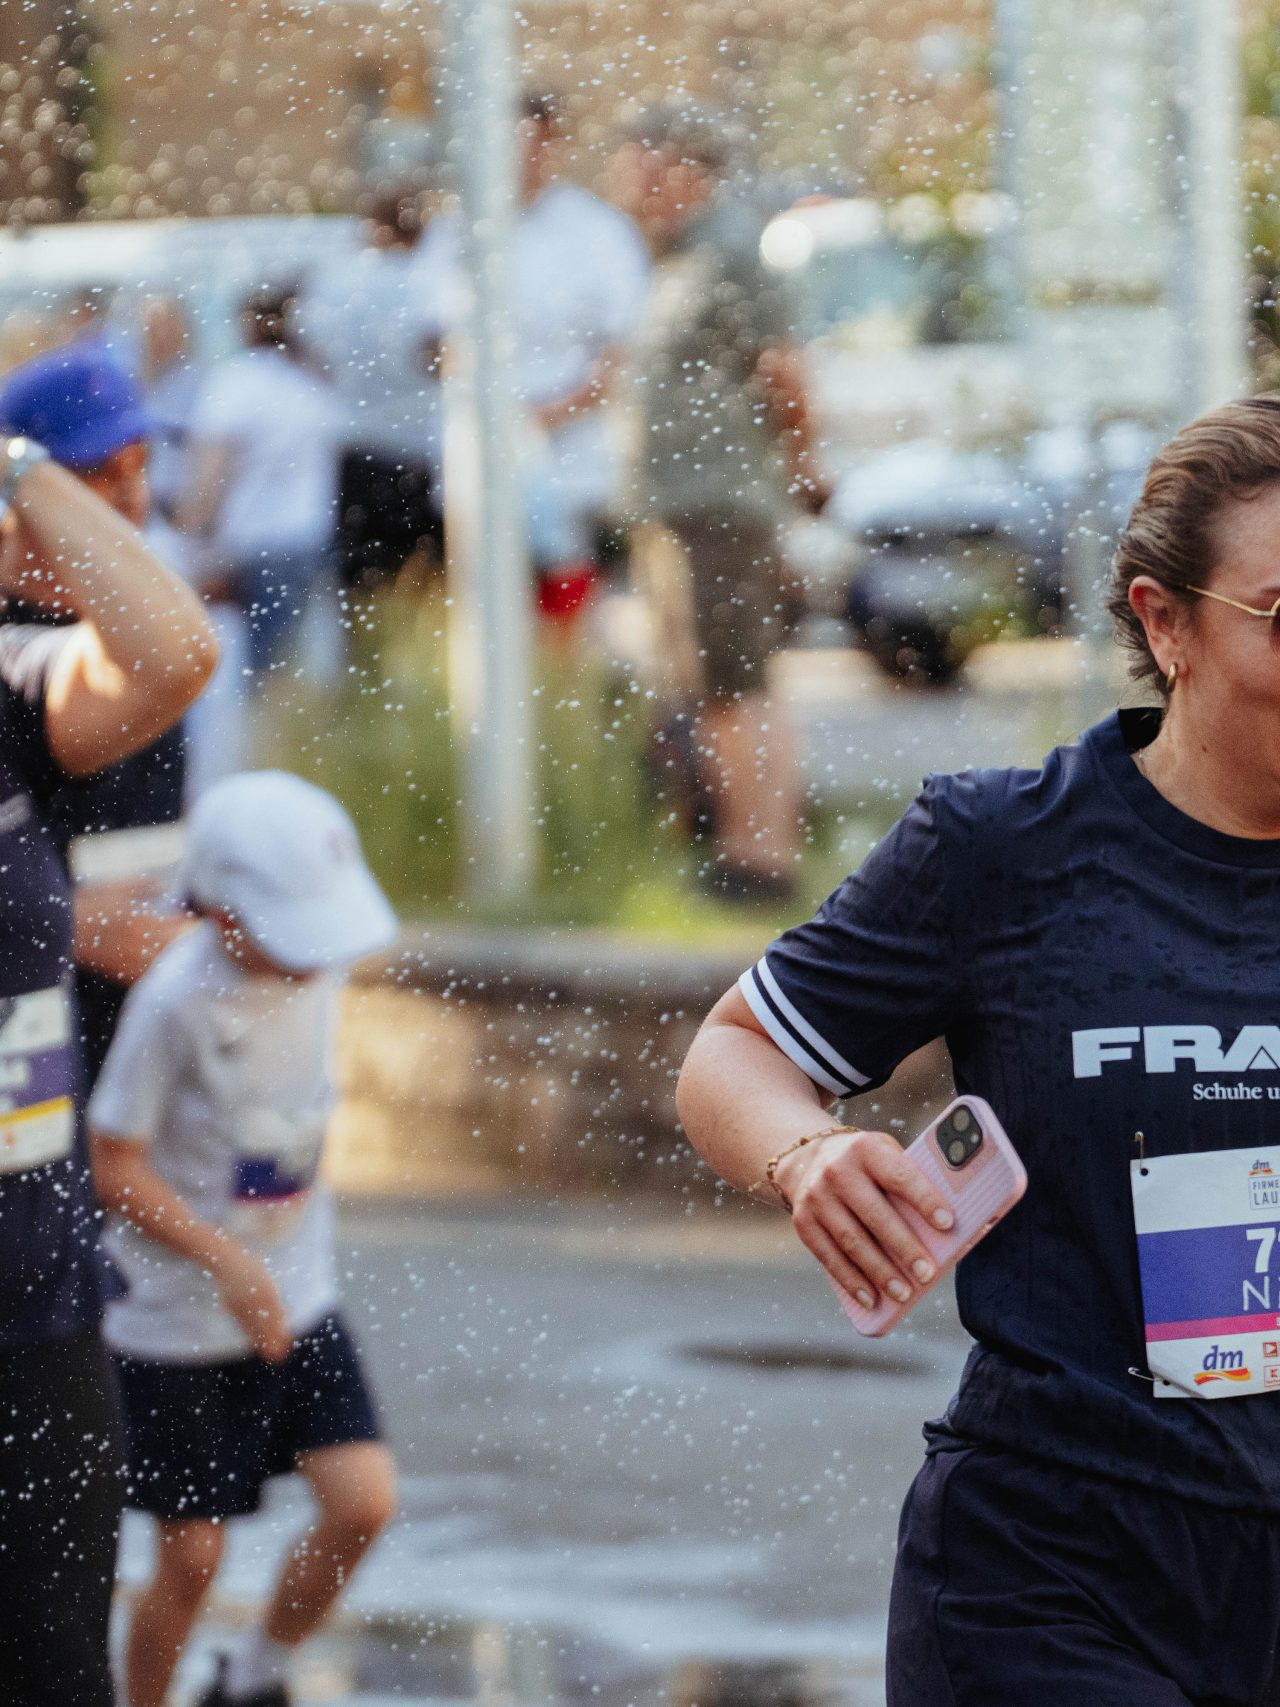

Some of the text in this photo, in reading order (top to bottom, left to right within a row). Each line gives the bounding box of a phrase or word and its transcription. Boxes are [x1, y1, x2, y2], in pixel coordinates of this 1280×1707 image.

[1192, 1082, 1263, 1101] Schuhe
[1252, 1159, 1270, 1170] dm
[1202, 1345, 1244, 1371] dm
